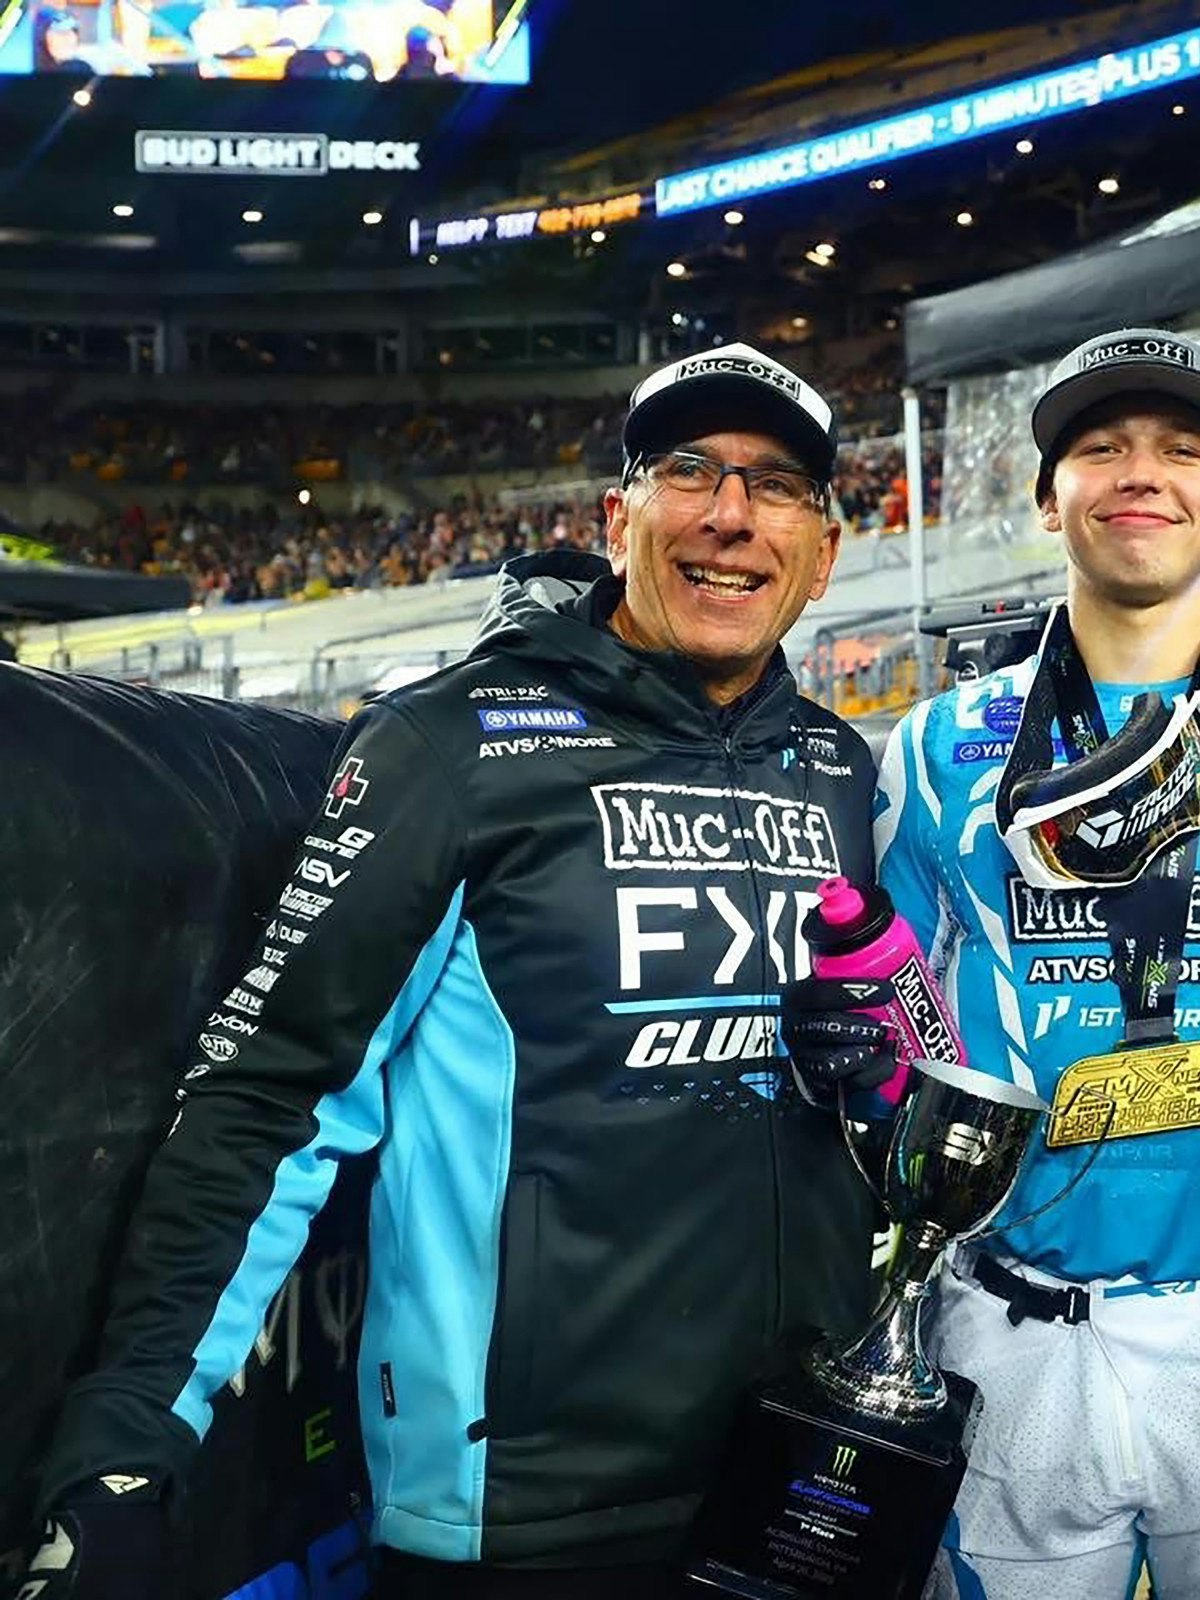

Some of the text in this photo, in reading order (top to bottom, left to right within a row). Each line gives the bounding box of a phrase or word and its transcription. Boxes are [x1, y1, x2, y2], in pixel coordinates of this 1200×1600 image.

[660, 173, 709, 209] LAST
[710, 149, 807, 193] CHANCE
[951, 104, 970, 135] 5
[1185, 37, 1200, 66] 1
[143, 138, 421, 170] BUD LIGHT DECK
[1084, 341, 1186, 369] Muc-Off
[506, 711, 580, 726] YAMAHA
[611, 796, 835, 869] Muc-Off
[897, 965, 959, 1064] Muc-Off
